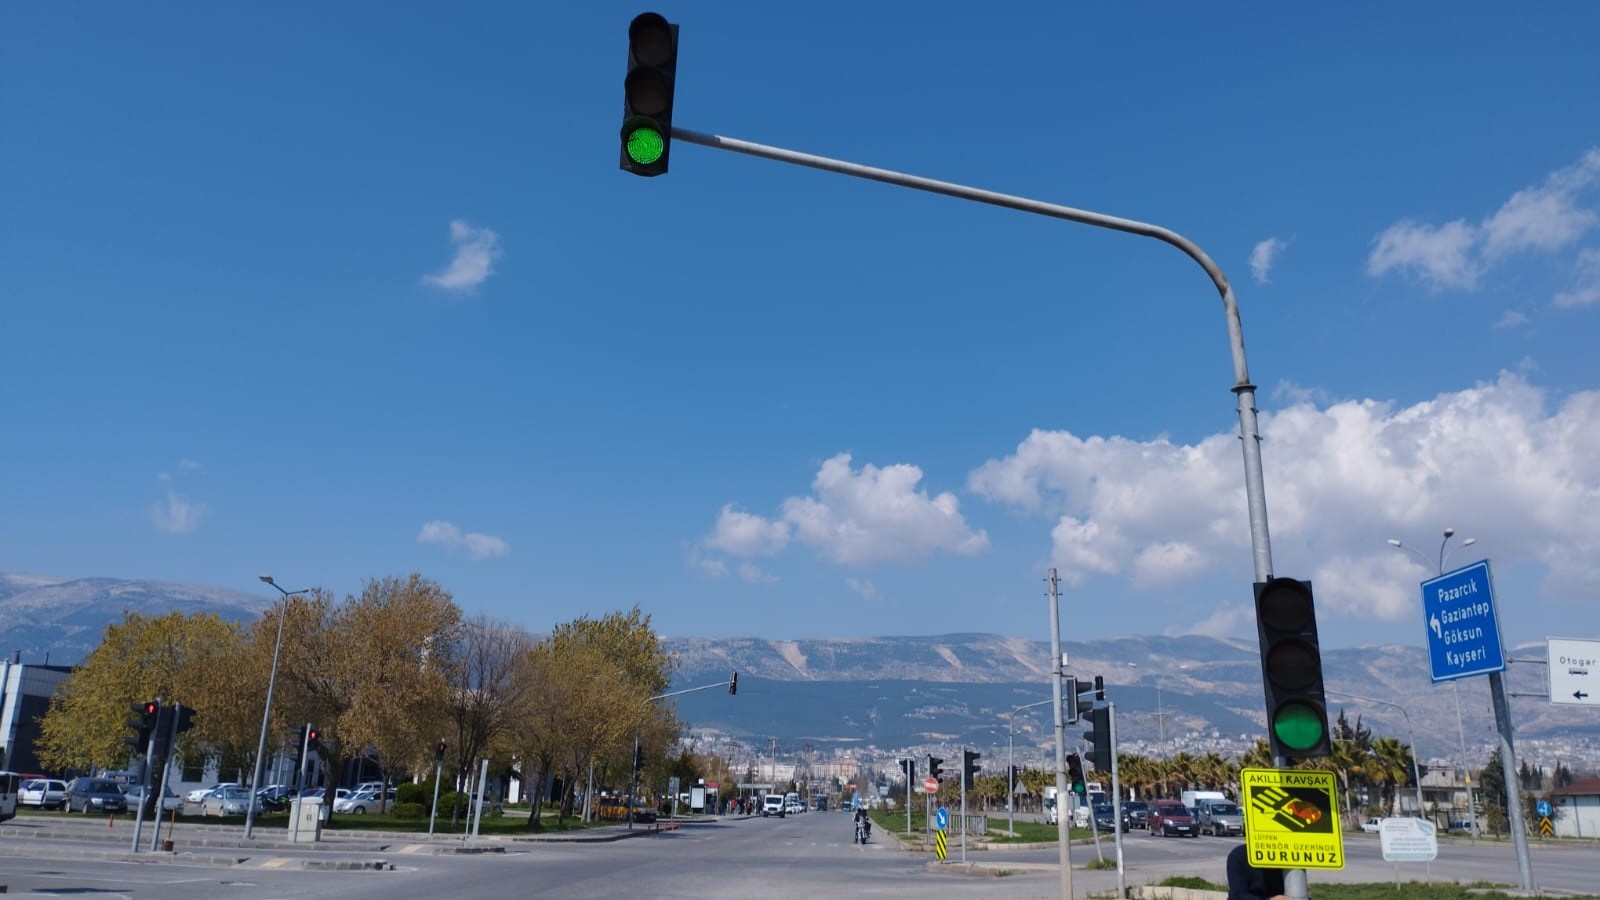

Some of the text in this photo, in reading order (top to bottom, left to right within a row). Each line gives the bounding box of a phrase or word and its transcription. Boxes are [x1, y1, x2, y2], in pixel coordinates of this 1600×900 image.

[1438, 579, 1477, 603] Pazarcık
[1441, 602, 1489, 624] Gaziantep
[1444, 627, 1482, 645] Göksun
[1446, 645, 1486, 668] Kayseri
[1559, 656, 1596, 667] Otogar
[1249, 775, 1329, 786] AKILLI KAVŞAK
[1255, 851, 1336, 863] DURUNUZ
